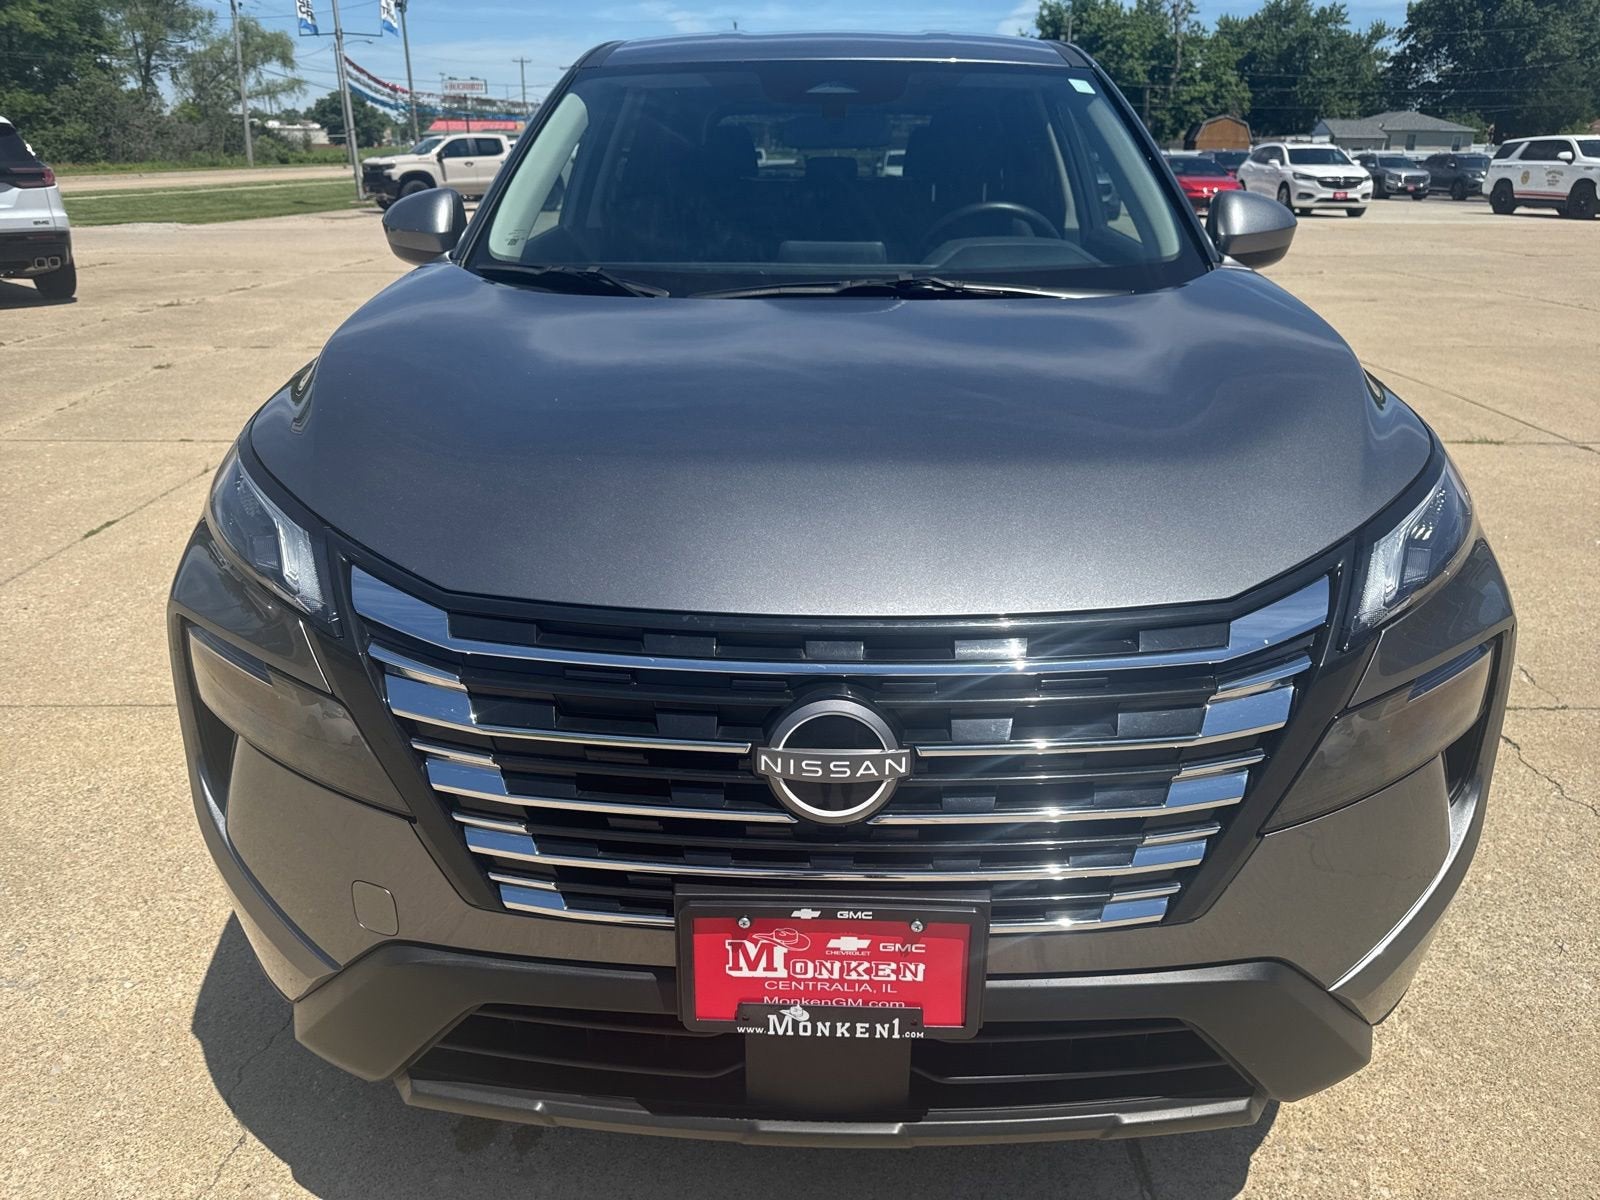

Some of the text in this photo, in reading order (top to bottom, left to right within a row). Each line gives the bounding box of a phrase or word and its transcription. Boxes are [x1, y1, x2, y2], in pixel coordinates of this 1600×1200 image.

[760, 755, 906, 778] NISSAN
[836, 910, 873, 920] GMC
[879, 943, 926, 953] GMC
[764, 980, 898, 994] CENTRALIA, IL
[763, 996, 905, 1008] MonkenGMcom
